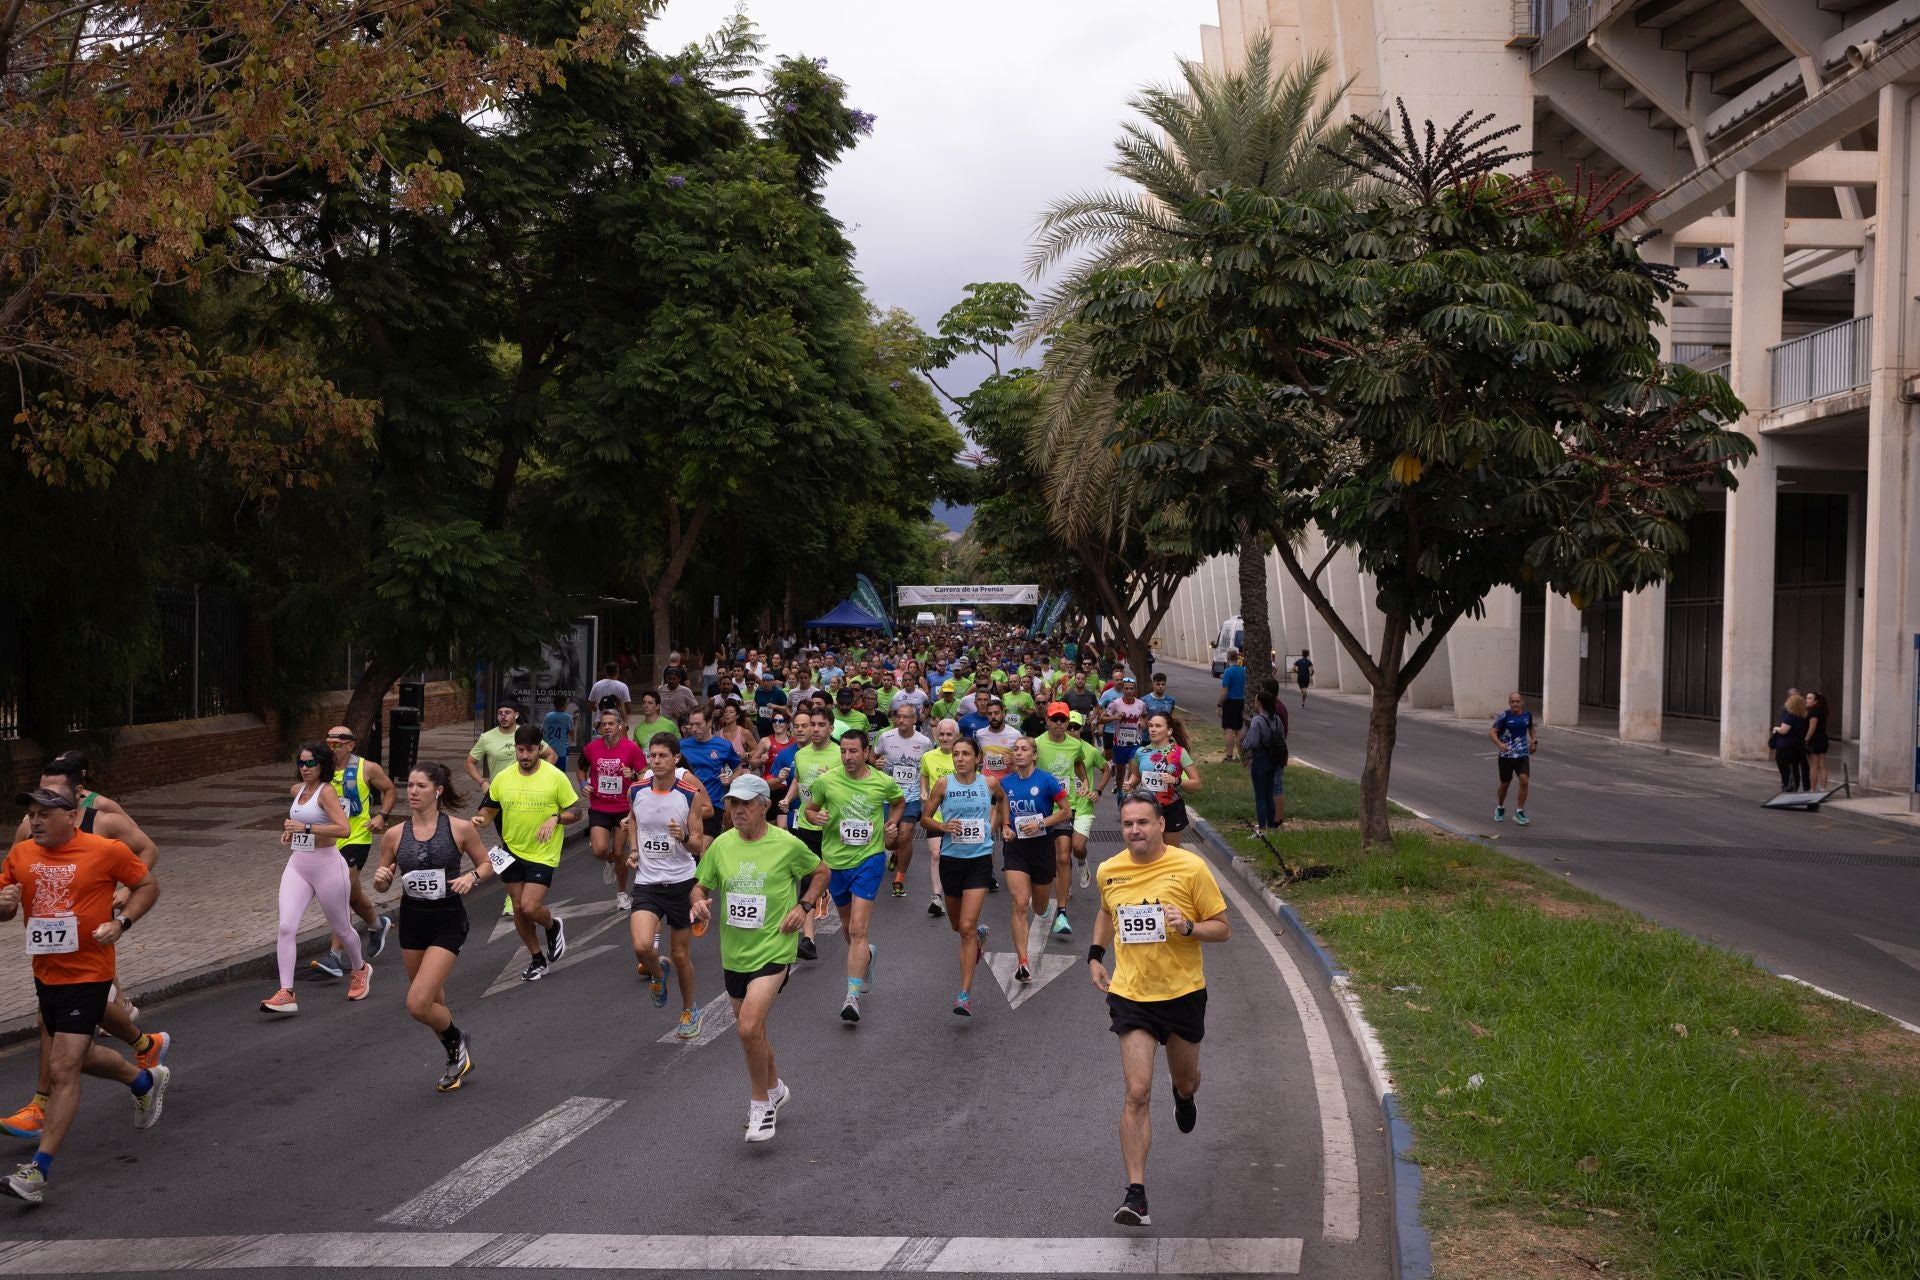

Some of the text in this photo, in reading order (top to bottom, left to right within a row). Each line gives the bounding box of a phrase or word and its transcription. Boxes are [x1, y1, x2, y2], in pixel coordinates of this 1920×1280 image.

[548, 726, 562, 740] 24
[896, 771, 913, 779] 170
[949, 789, 979, 799] nerja
[1009, 799, 1037, 813] RCM
[844, 828, 869, 838] 169
[644, 840, 670, 851] 459
[408, 880, 439, 891] 255
[730, 904, 758, 919] 832
[1123, 917, 1157, 932] 599
[32, 930, 67, 943] 817
